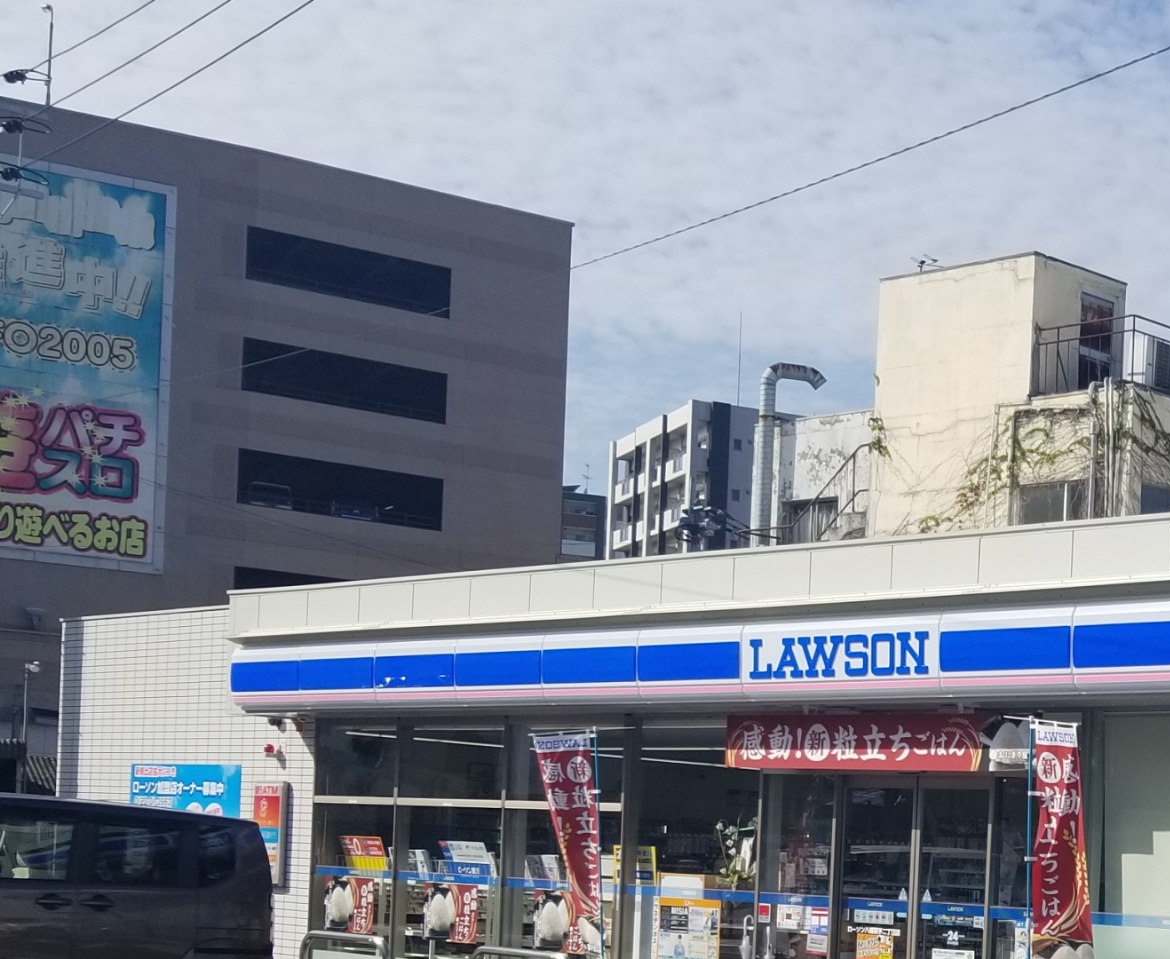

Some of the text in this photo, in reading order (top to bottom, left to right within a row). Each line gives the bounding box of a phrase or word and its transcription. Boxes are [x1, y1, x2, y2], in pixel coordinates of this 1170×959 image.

[0, 238, 152, 318] 進中!!
[0, 319, 137, 371] O2005
[749, 631, 929, 679] LAWSON
[1037, 730, 1075, 744] LAWSON
[947, 930, 959, 941] 24
